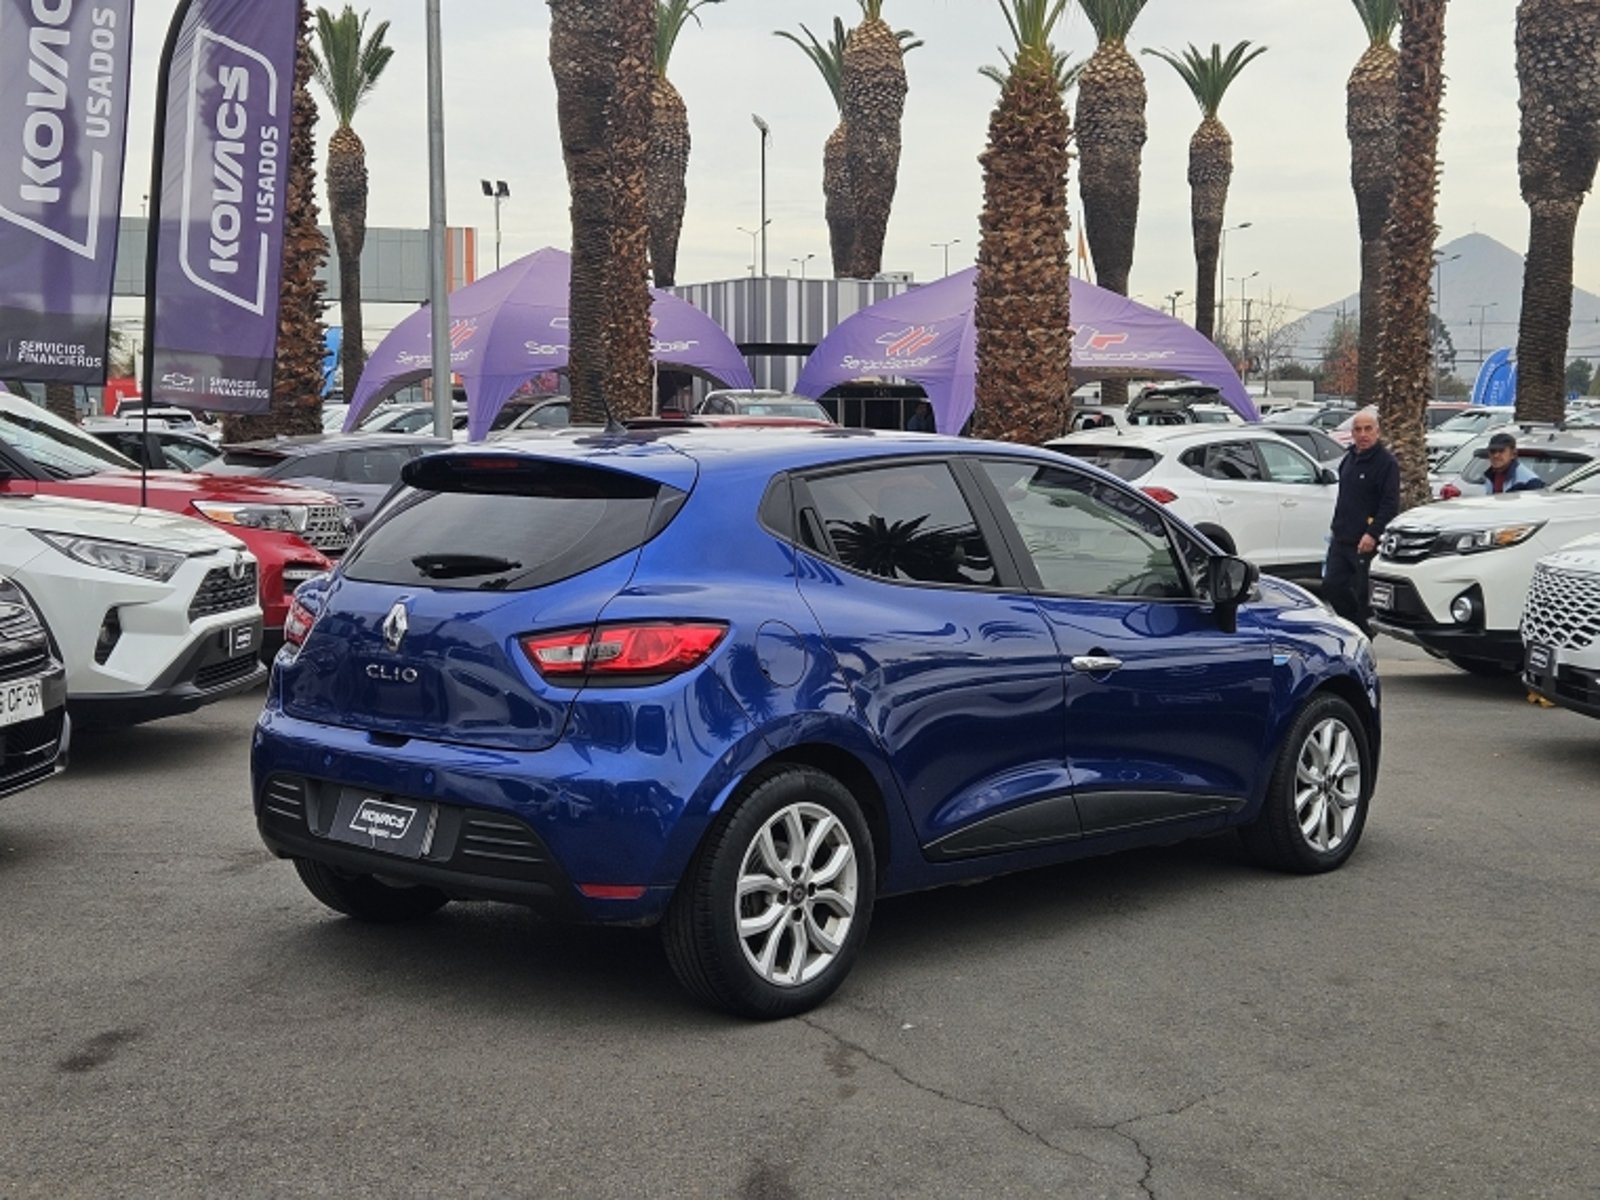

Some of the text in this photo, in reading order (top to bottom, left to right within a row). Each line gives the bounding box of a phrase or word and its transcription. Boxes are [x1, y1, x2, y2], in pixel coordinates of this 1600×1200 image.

[86, 7, 117, 138] USADOS
[208, 65, 249, 273] KOVACS
[255, 125, 279, 223] USADOS
[19, 340, 86, 354] SERVICIOS
[18, 352, 102, 368] FINANCIEROS
[365, 664, 418, 683] CLIO
[361, 808, 406, 829] KOVACS
